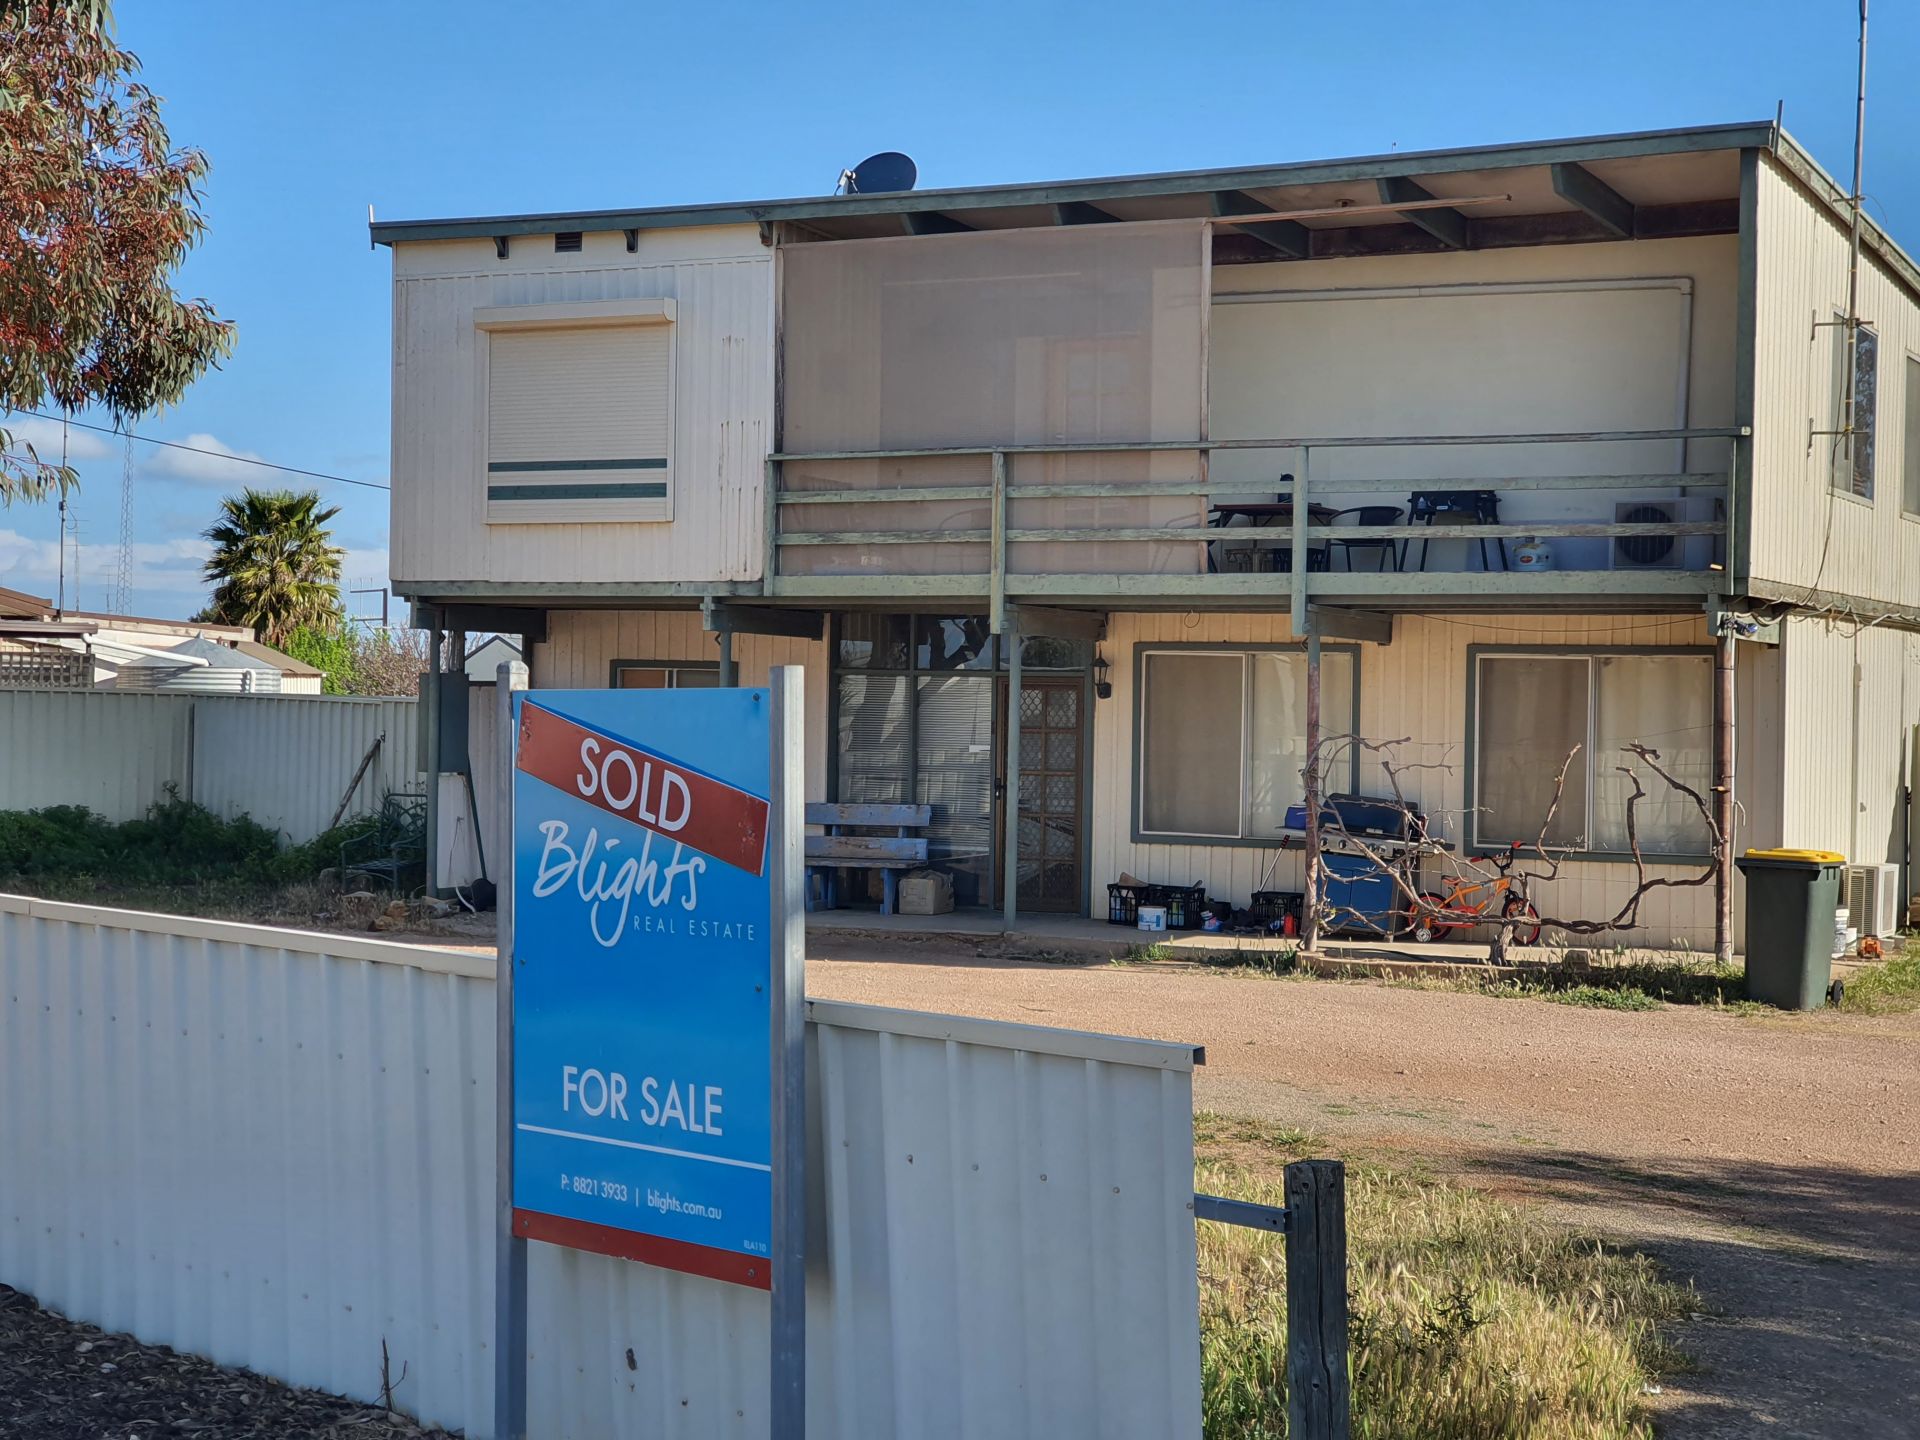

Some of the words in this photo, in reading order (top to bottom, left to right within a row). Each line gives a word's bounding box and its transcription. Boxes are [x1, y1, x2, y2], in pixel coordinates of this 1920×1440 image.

[577, 737, 691, 832] SOLD
[533, 820, 706, 947] Blights
[634, 915, 675, 934] REAL
[689, 919, 754, 941] ESTATE
[563, 1065, 630, 1121] FOR
[640, 1077, 723, 1136] SALE
[573, 1176, 598, 1196] 8821
[601, 1181, 628, 1201] 3933
[647, 1188, 722, 1220] blights.com.au
